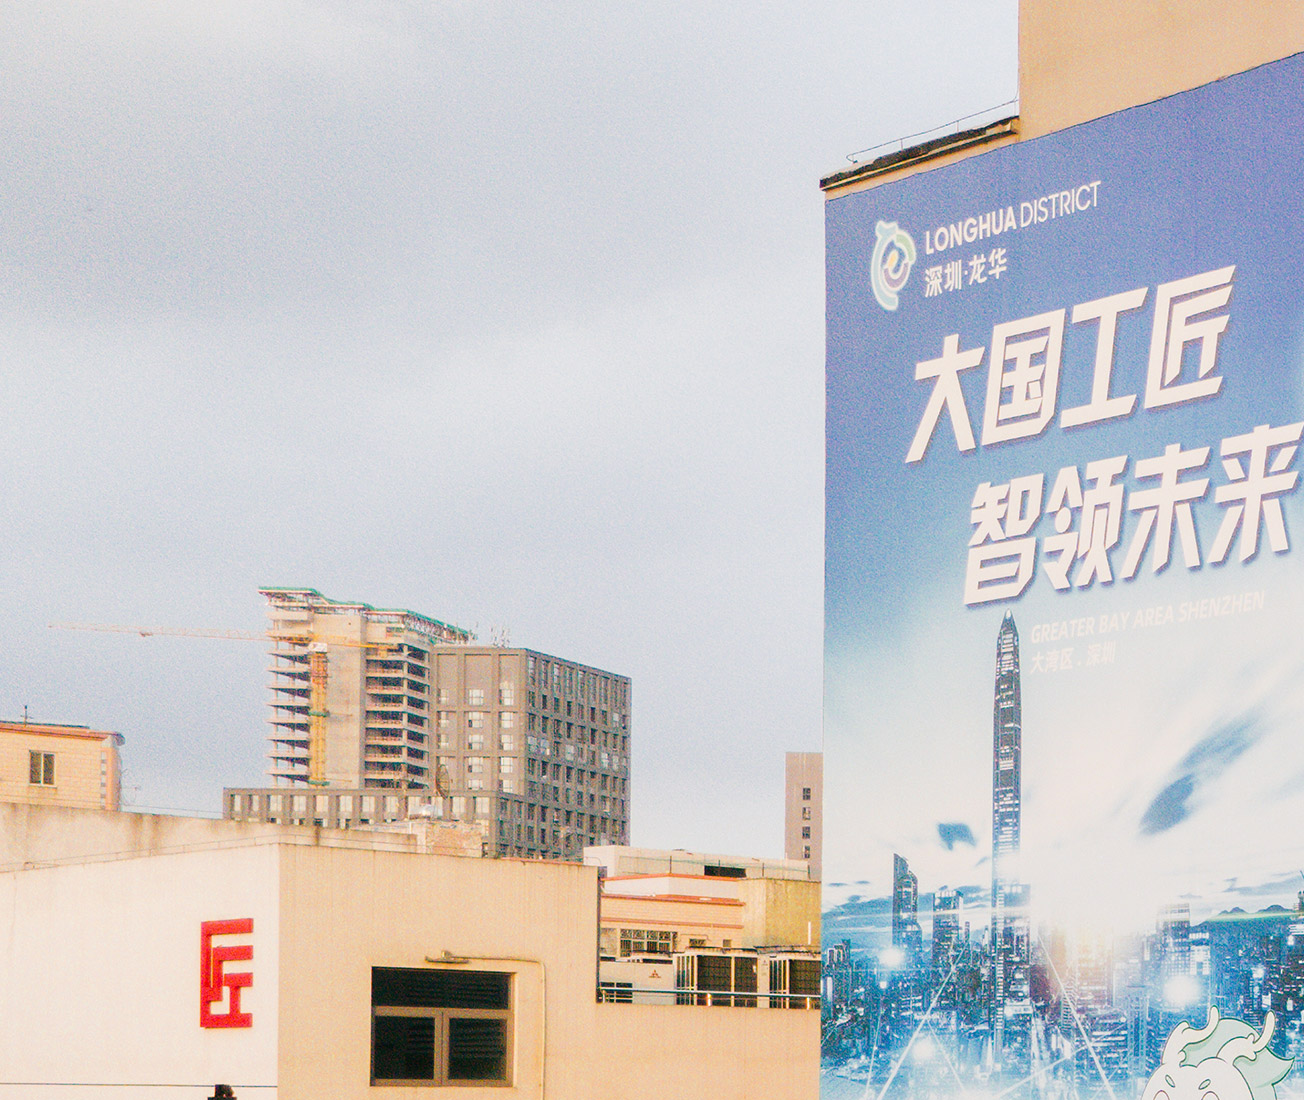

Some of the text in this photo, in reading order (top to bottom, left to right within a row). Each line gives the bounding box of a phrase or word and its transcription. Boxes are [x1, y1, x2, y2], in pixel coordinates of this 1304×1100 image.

[925, 180, 1102, 256] LONGHUA DISTRICT
[904, 264, 1238, 465] 大国工匠
[1030, 590, 1266, 645] GREATER BAY AREA SHENZHEN
